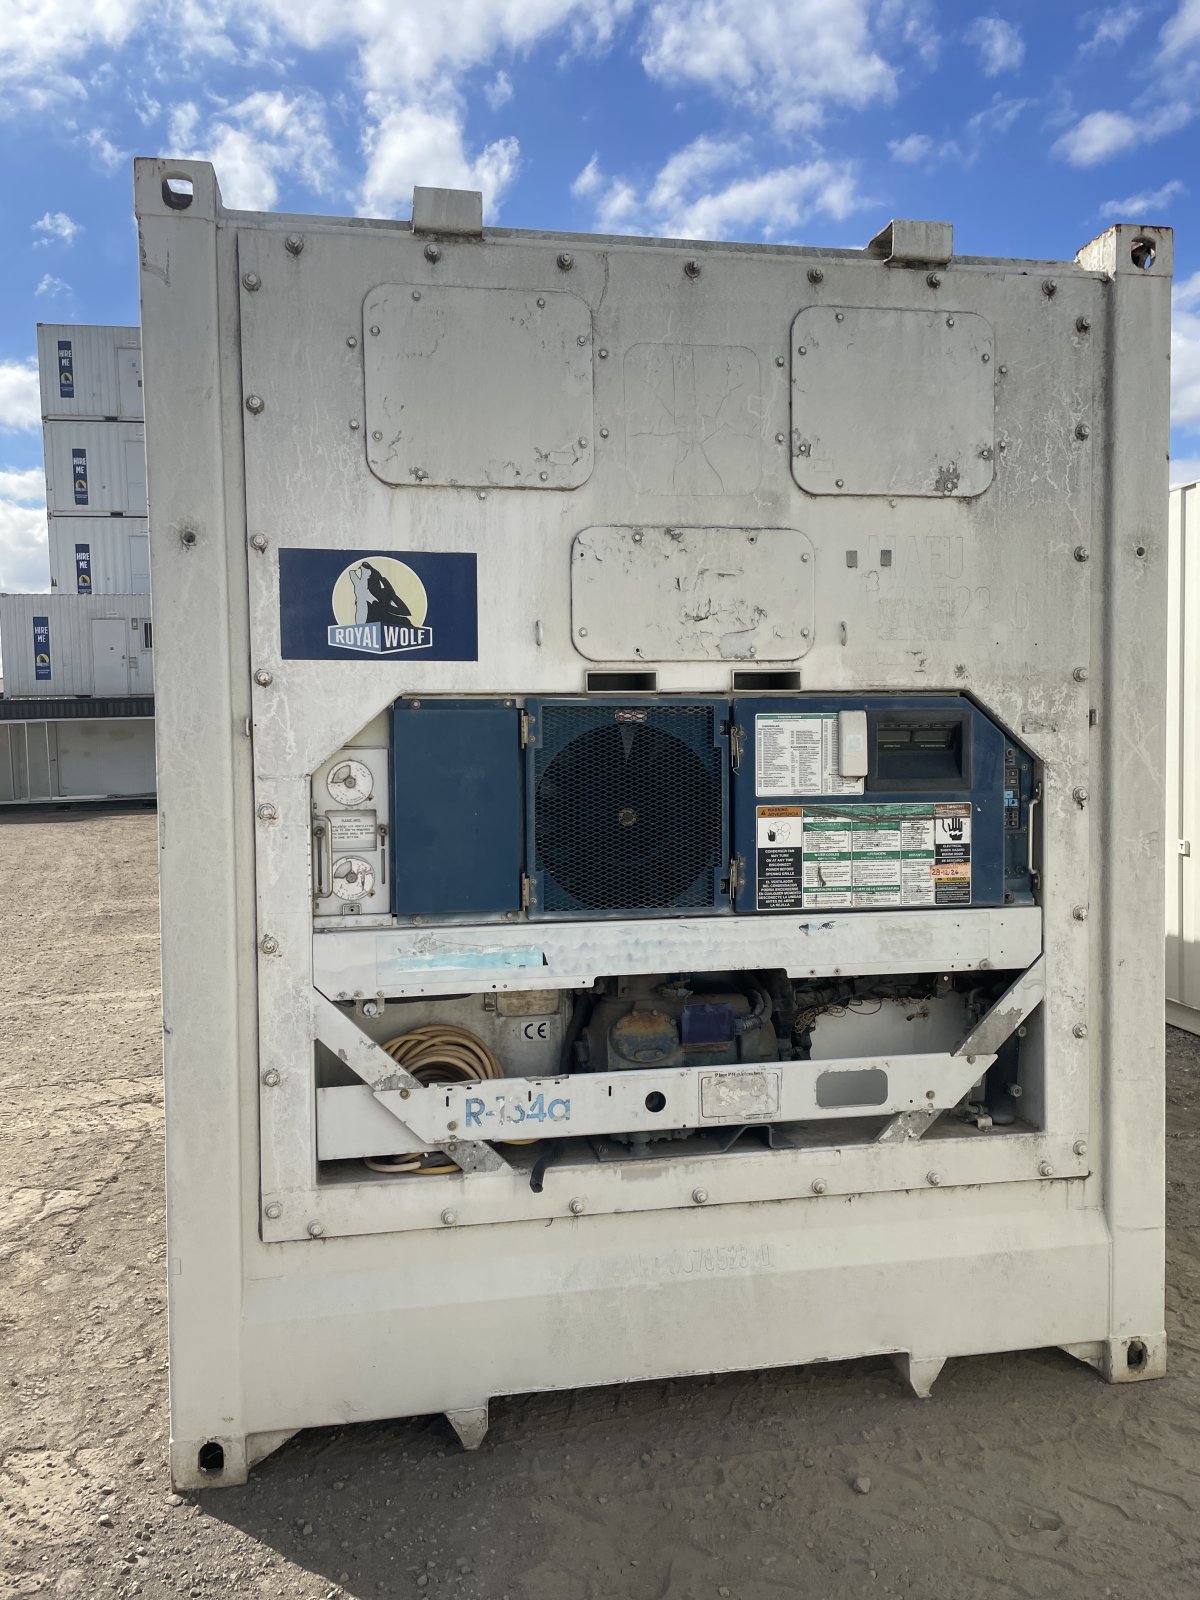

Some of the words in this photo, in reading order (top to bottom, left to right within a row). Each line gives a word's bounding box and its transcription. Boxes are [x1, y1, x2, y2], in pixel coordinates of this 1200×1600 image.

[336, 626, 379, 648] ROYAL
[384, 626, 425, 648] WOLF
[524, 1022, 546, 1039] CE
